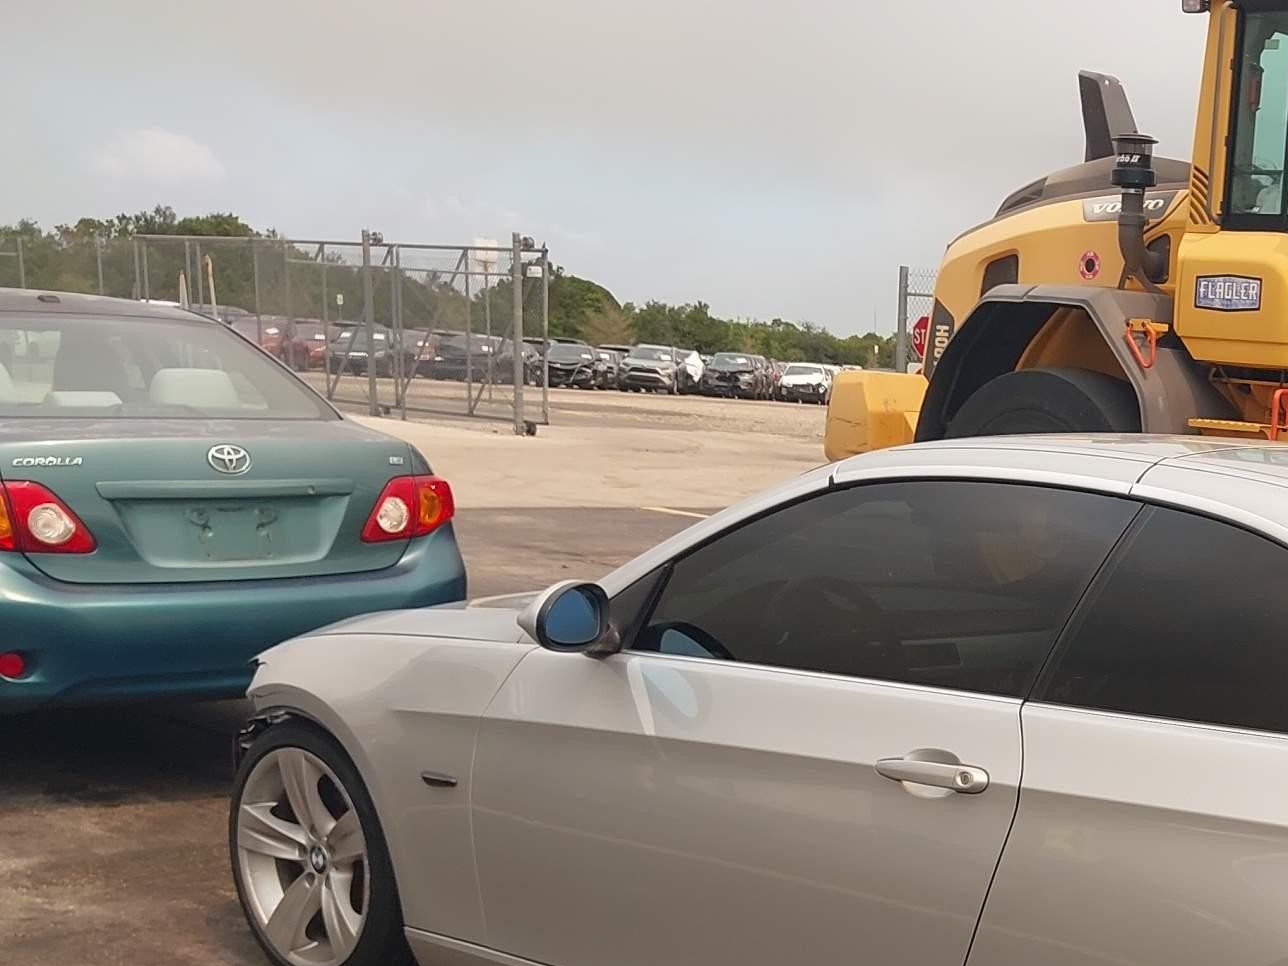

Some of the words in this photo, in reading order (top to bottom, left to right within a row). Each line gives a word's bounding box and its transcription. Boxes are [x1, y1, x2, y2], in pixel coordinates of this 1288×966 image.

[1200, 281, 1258, 300] FLAGLER
[914, 328, 927, 345] ST
[12, 456, 83, 467] COROLLA
